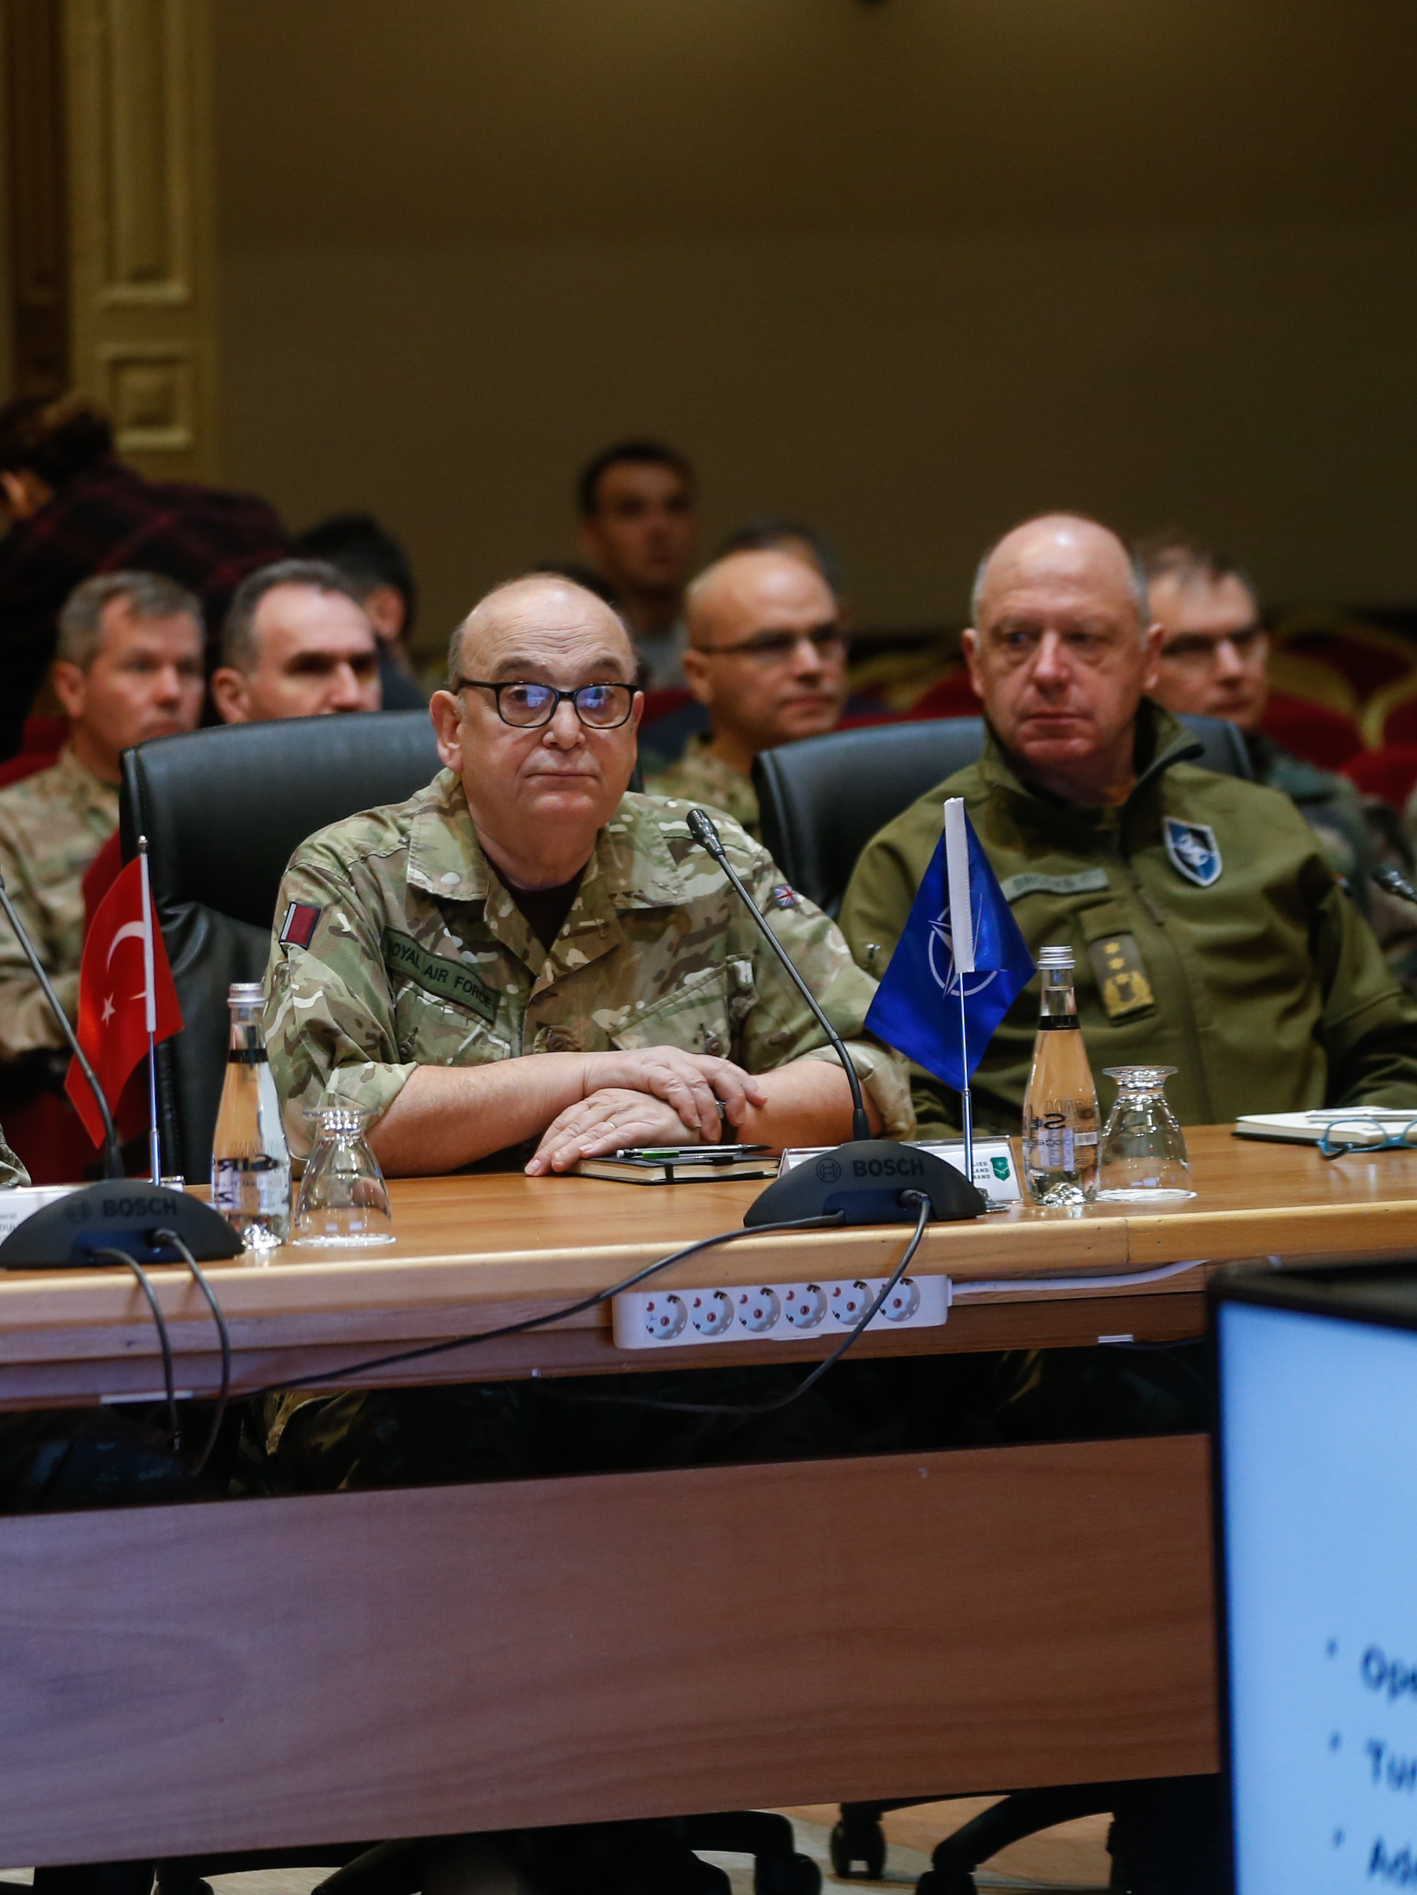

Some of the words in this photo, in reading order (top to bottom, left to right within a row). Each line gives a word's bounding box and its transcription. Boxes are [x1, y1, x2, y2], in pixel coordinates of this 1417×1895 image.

[423, 964, 449, 983] AIR
[454, 976, 492, 1010] FORCE
[853, 1156, 926, 1177] BOSCH
[103, 1197, 178, 1217] BOSCH
